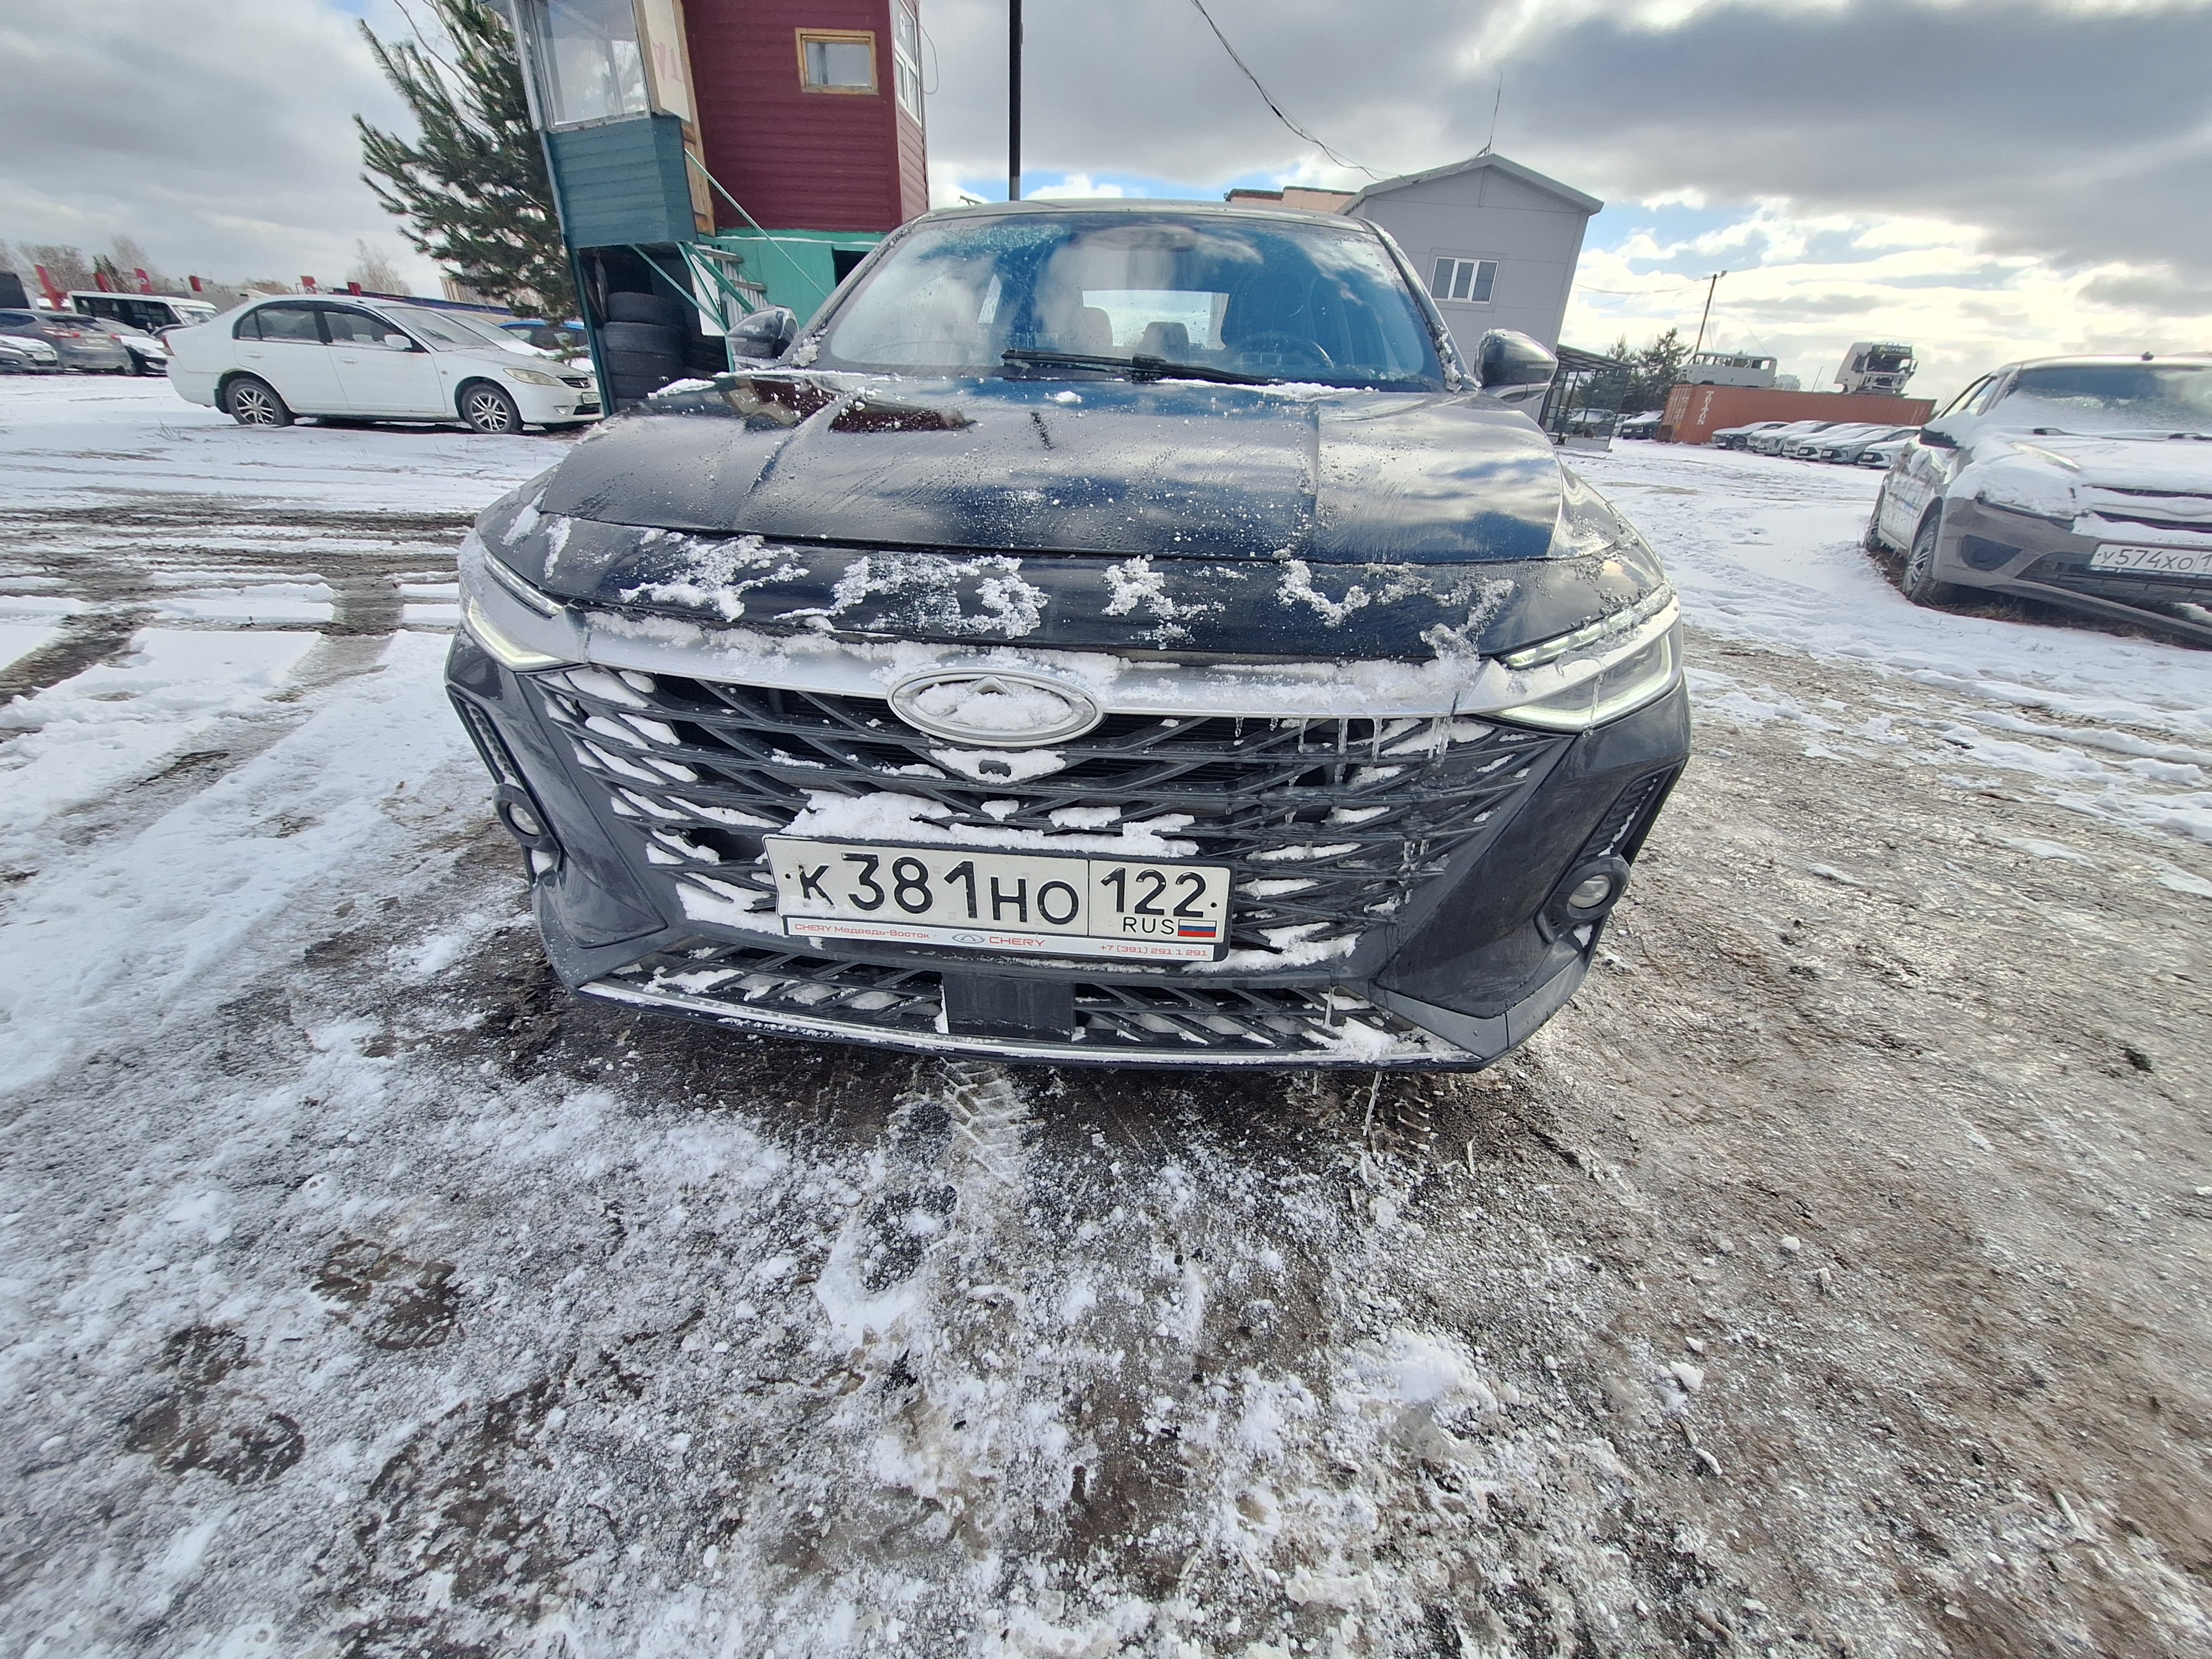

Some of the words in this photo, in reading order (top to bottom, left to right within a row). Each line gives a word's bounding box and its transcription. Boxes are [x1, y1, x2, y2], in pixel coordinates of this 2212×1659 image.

[798, 852, 1079, 925] К381НО
[1100, 867, 1207, 918] 122
[794, 923, 832, 932] CHERY
[834, 926, 930, 939] Медведь-Восток
[1122, 916, 1176, 935] RUS
[988, 936, 1046, 947] CHERY
[1117, 945, 1148, 954] (391)
